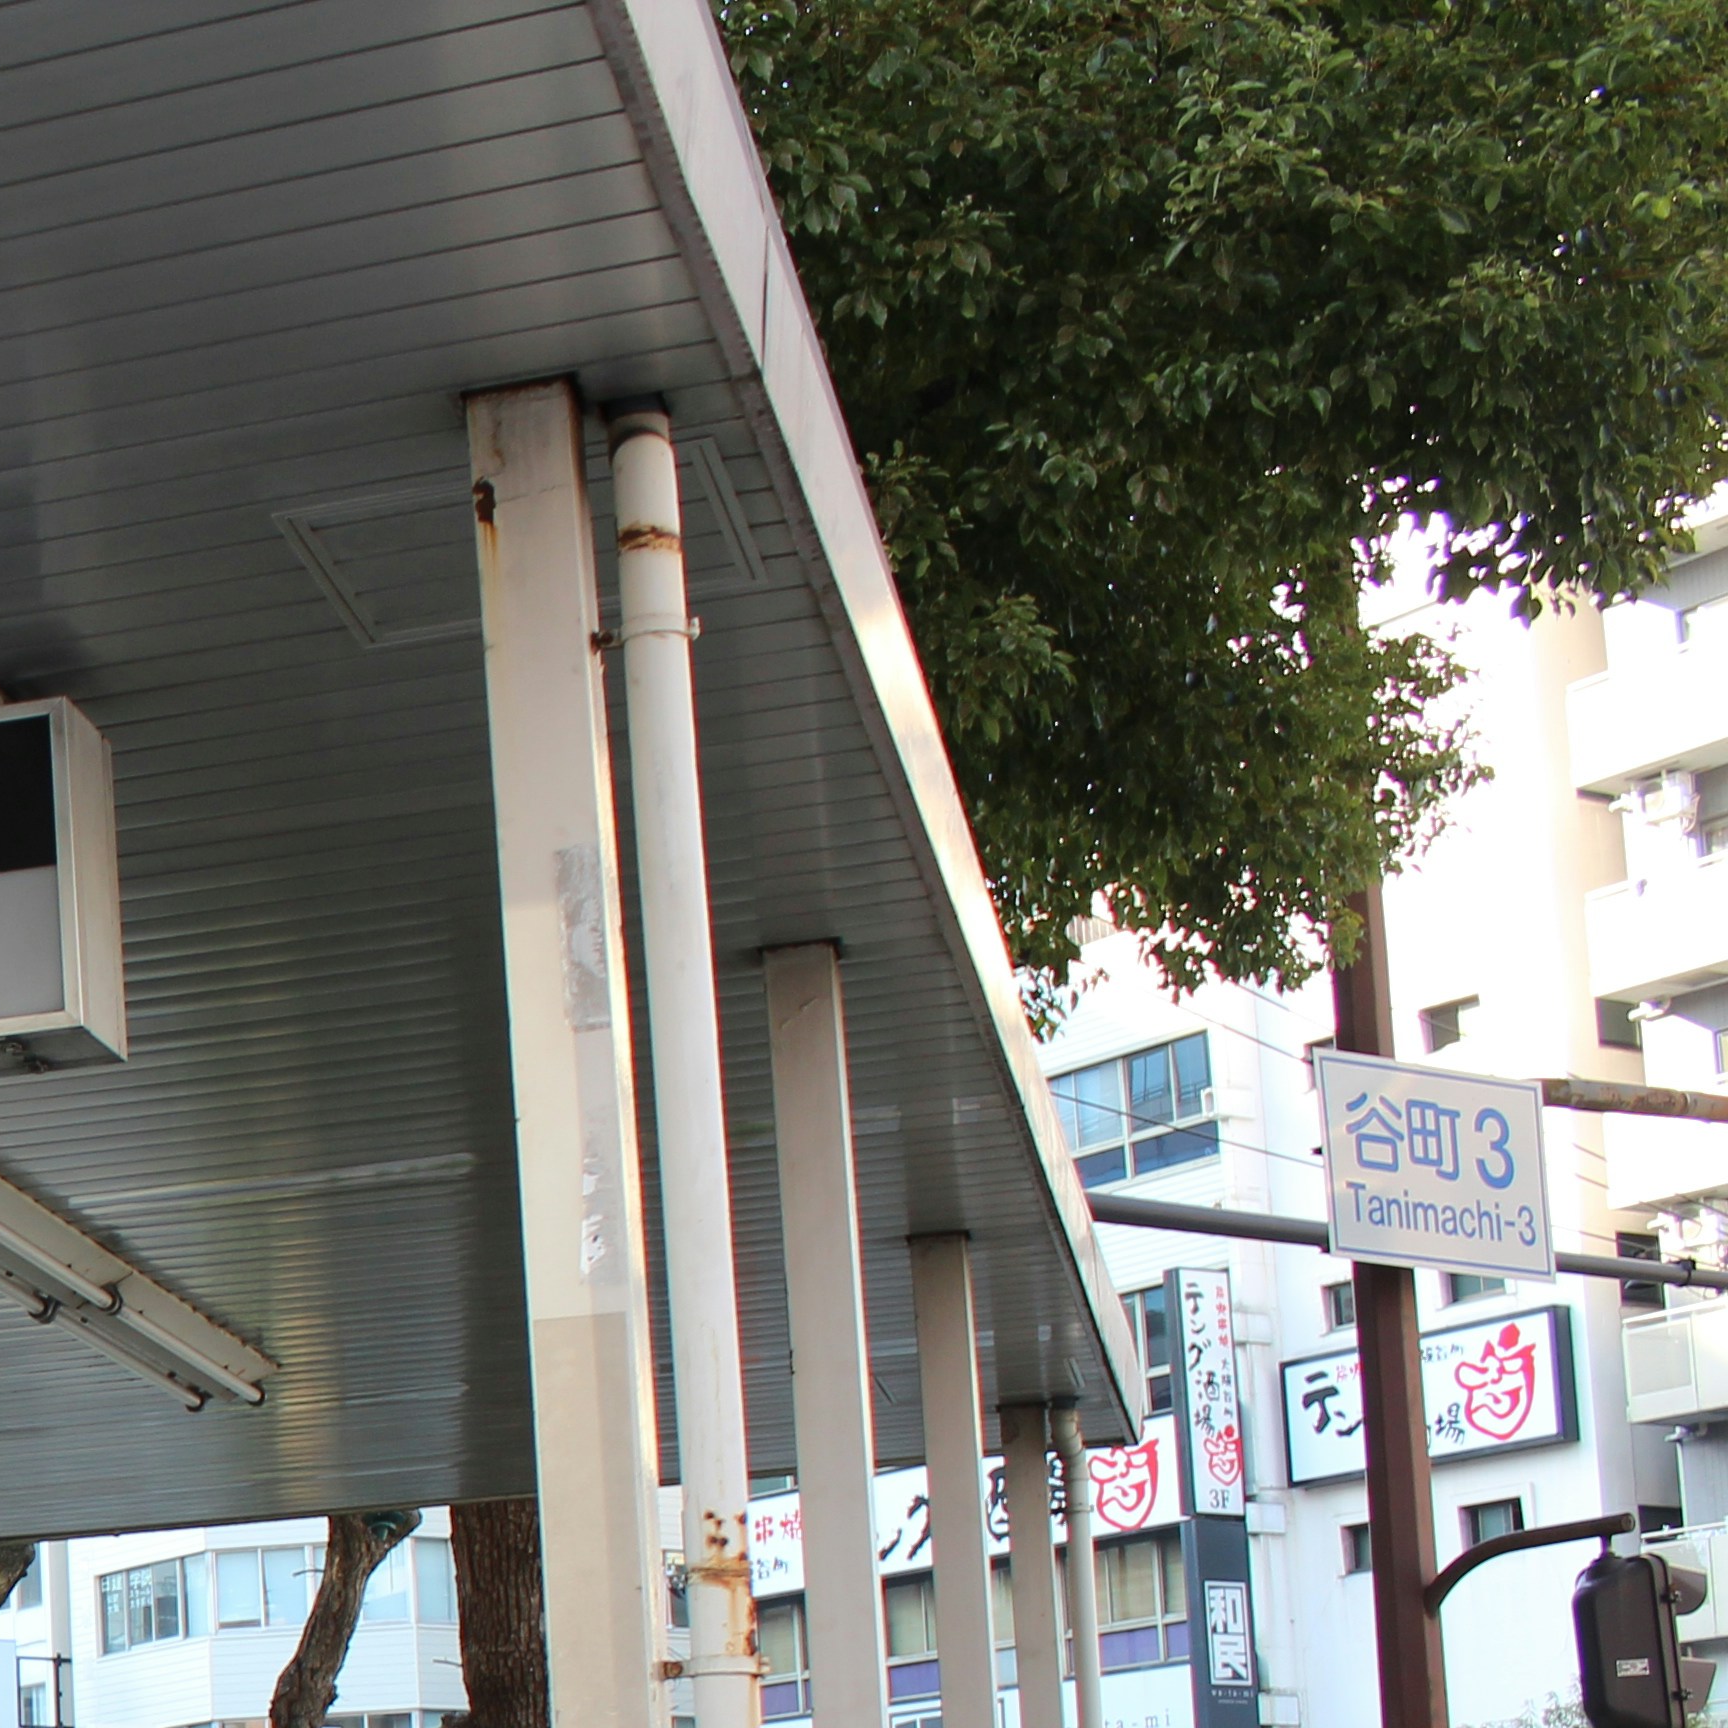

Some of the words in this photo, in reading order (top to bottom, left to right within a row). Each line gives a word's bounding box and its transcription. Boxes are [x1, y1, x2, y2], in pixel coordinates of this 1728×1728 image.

[1344, 1180, 1537, 1247] Tanimachi-3
[1210, 1489, 1230, 1509] 3F
[1209, 1588, 1249, 1681] 和民
